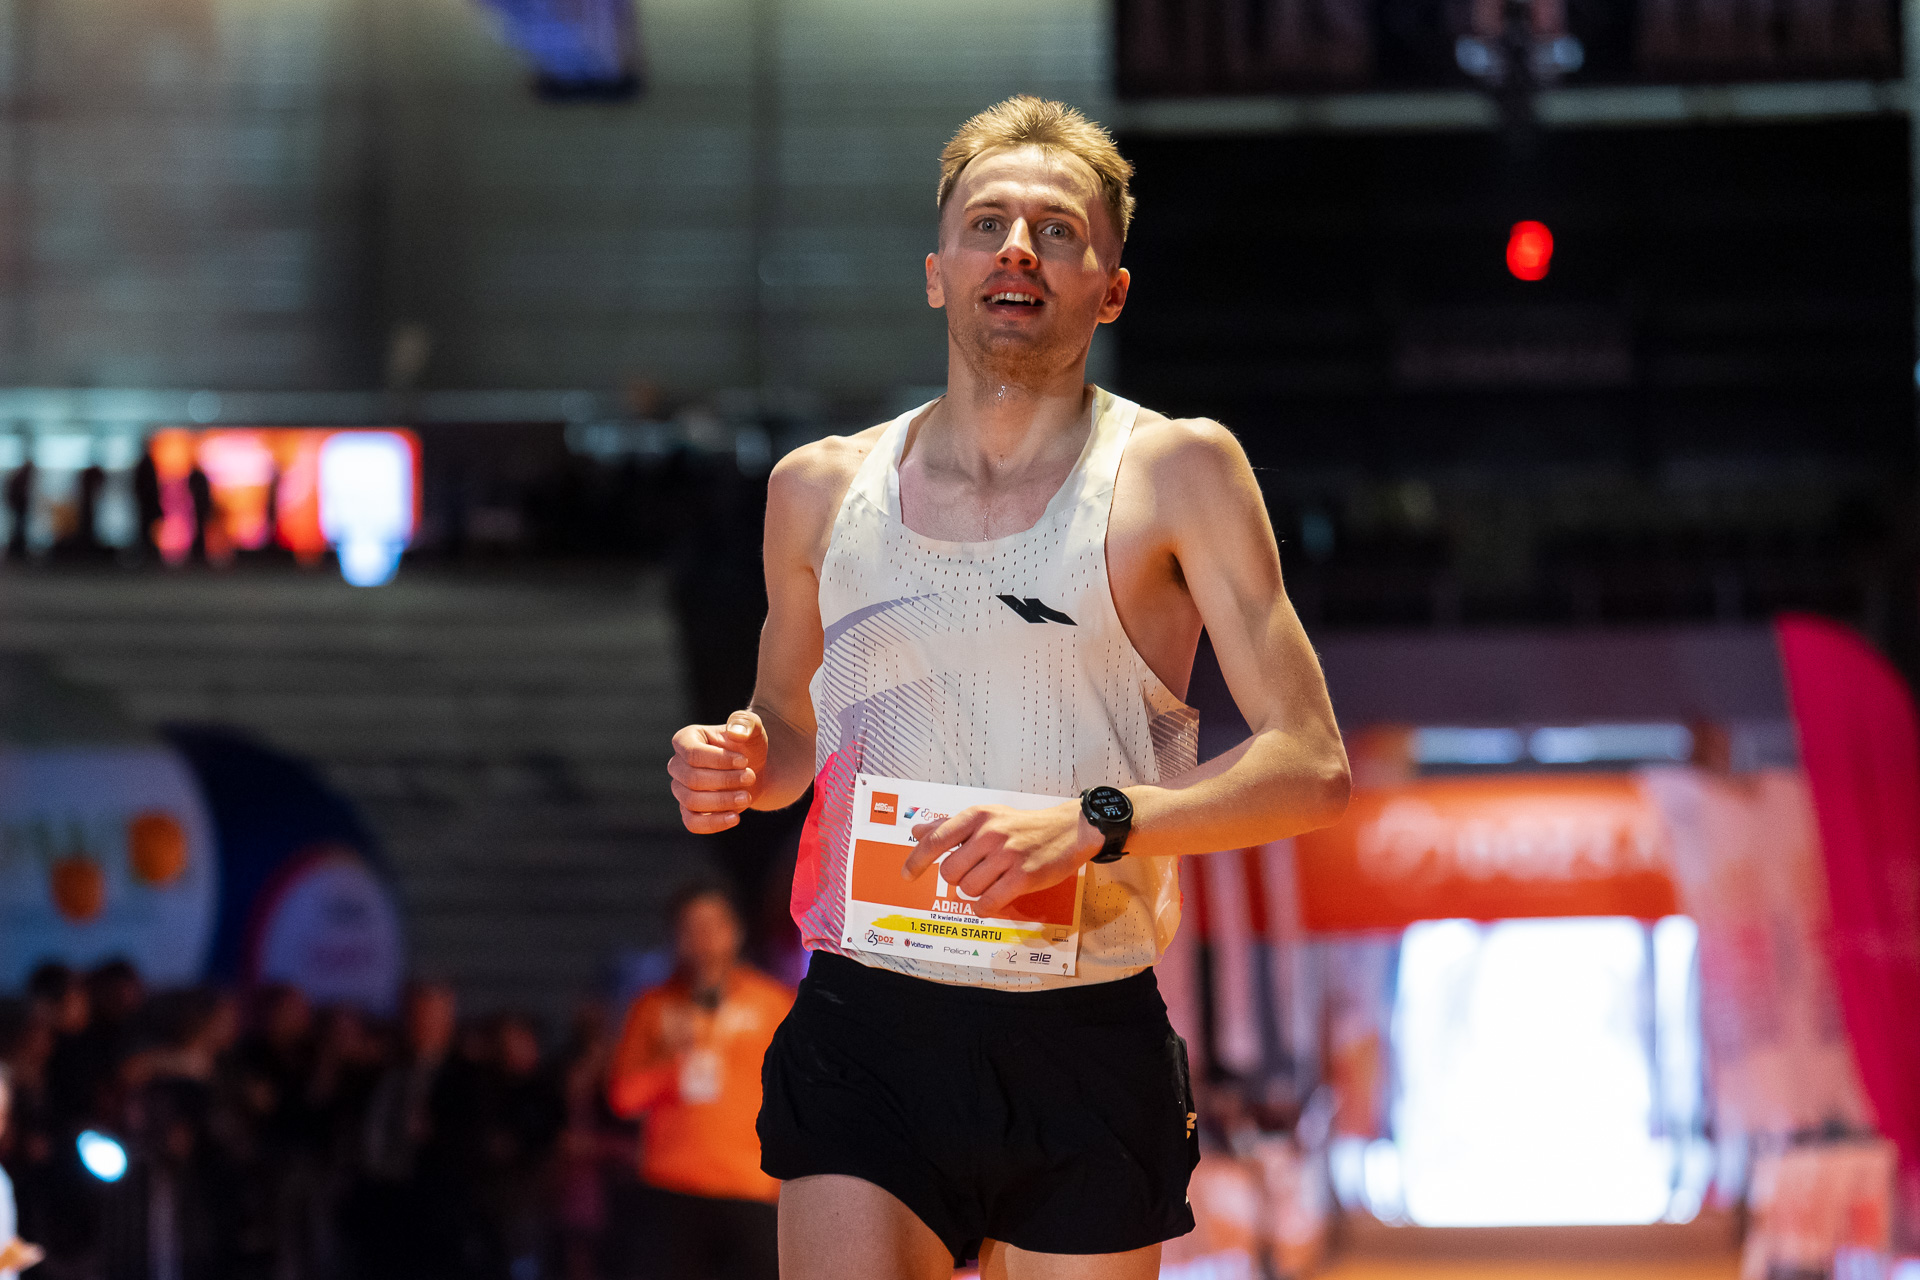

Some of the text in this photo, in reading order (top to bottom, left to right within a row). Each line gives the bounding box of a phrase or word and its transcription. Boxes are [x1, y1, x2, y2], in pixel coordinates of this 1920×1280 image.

[931, 899, 976, 915] ADRIA
[937, 914, 962, 922] kwietnia
[911, 922, 1002, 941] 1. STREFA STARTU
[910, 940, 934, 950] Voltaren
[943, 946, 971, 956] Pelion
